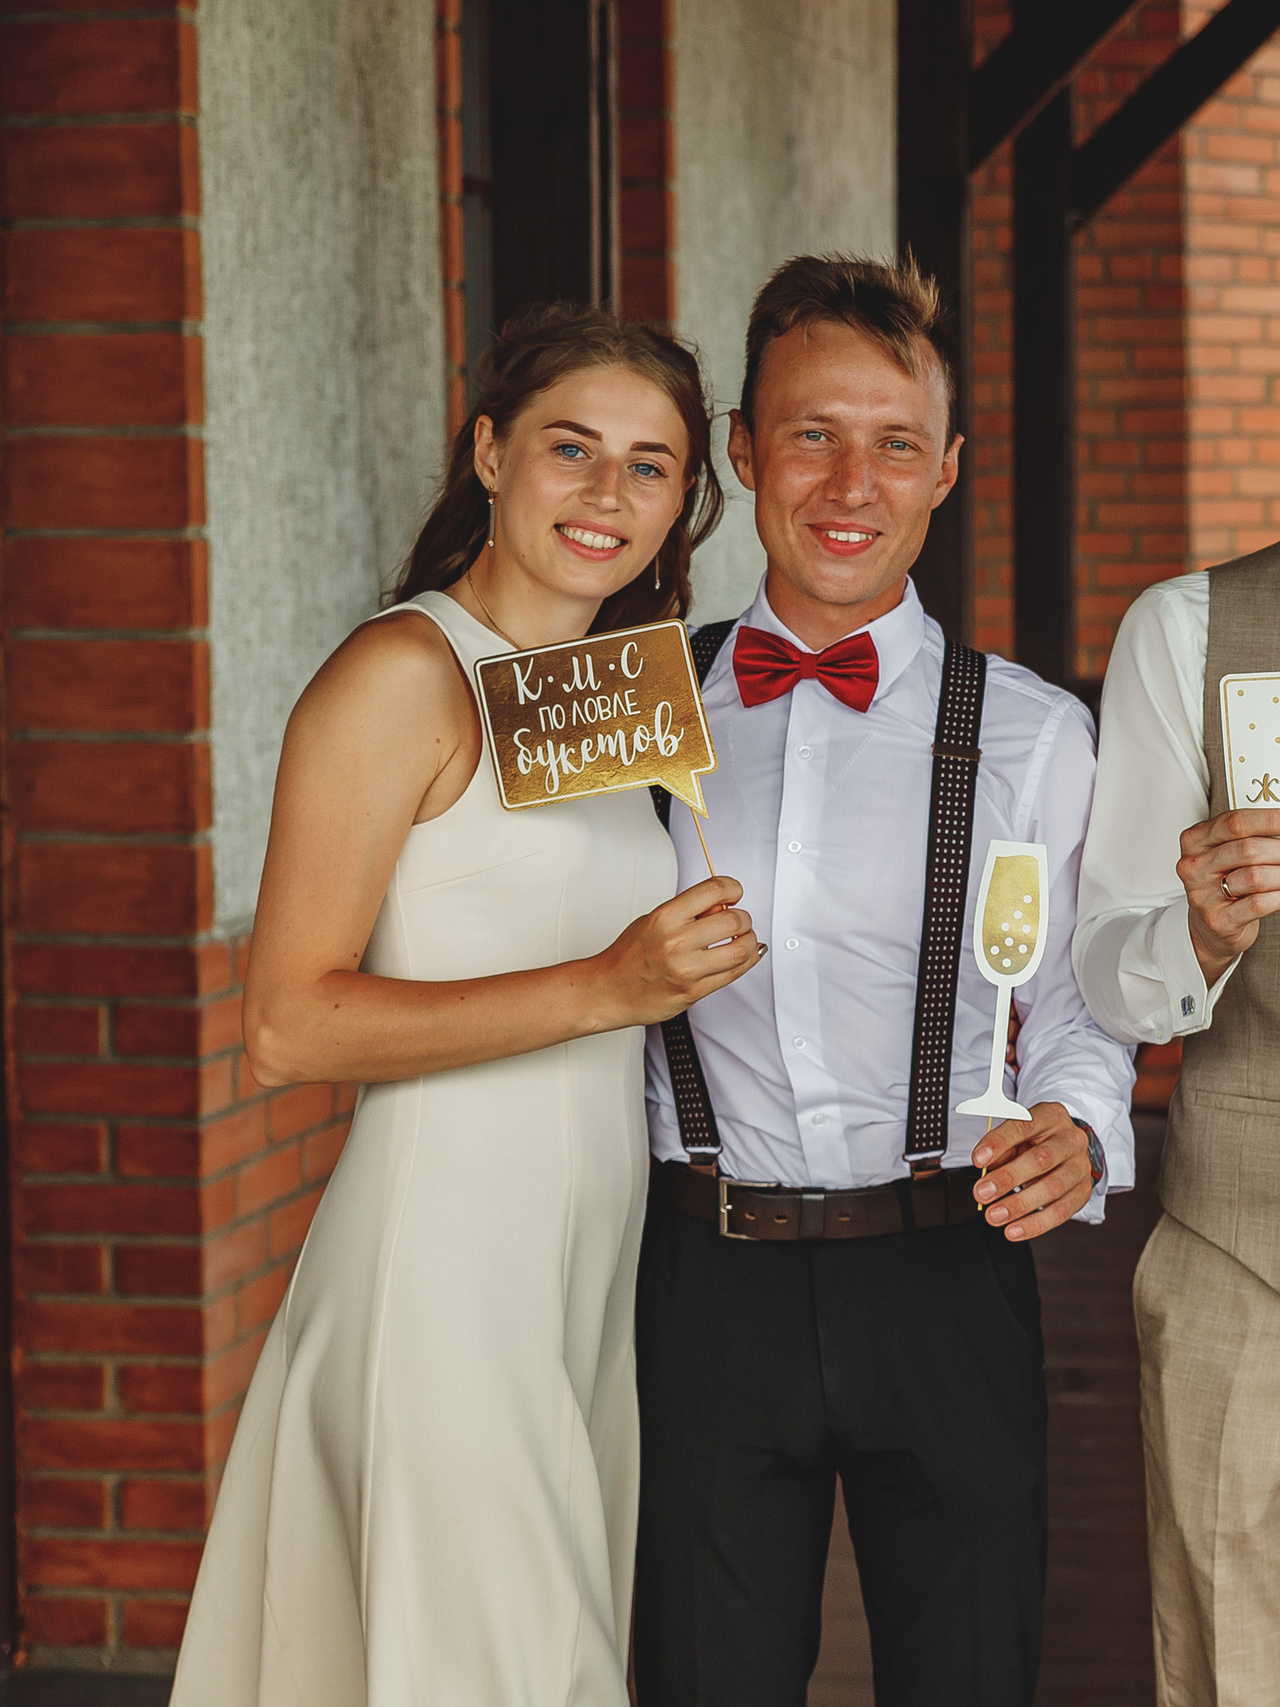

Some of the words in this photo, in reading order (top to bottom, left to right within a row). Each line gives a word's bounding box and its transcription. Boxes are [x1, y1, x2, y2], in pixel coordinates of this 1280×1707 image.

[538, 703, 566, 733] ПО
[571, 689, 641, 727] ЛОВЛЕ
[513, 701, 685, 794] букетов
